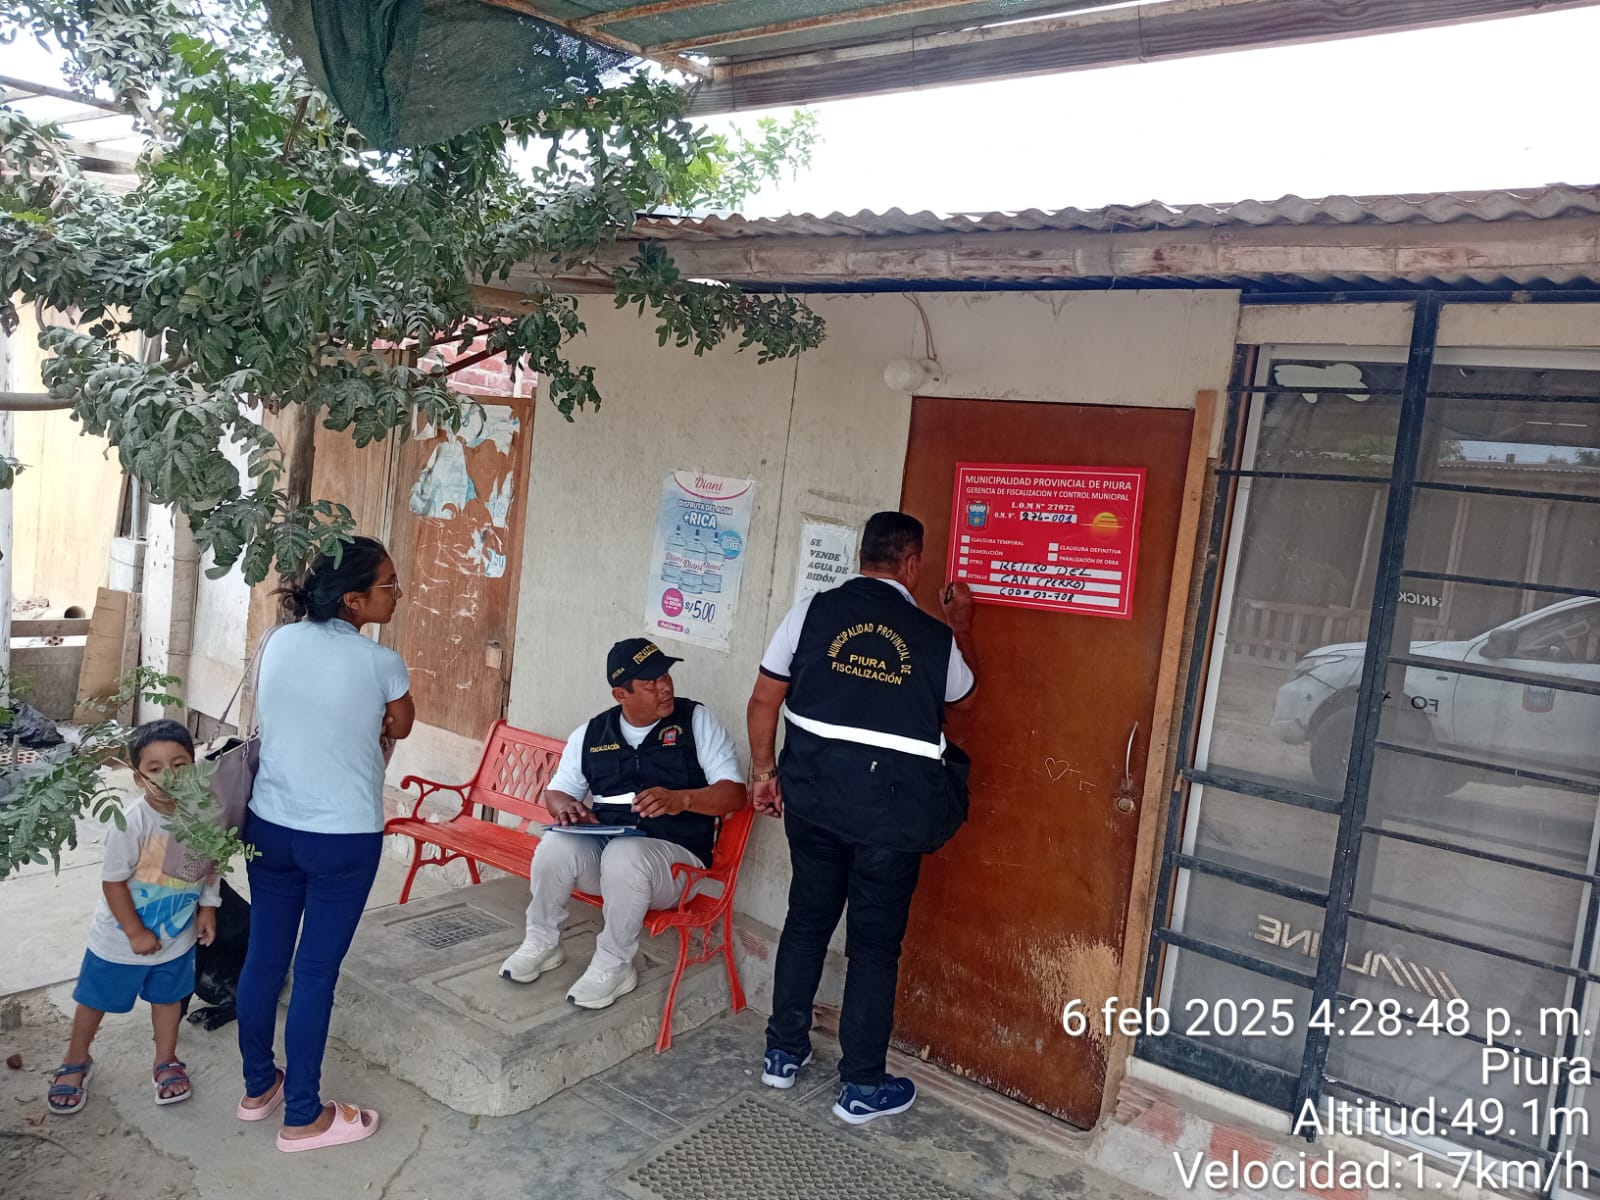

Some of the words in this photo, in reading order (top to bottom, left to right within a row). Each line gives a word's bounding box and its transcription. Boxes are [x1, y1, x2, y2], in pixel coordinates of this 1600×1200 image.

[694, 476, 723, 492] Diani
[965, 475, 1032, 486] MUNICIPALIDAD
[1033, 478, 1086, 488] PROVINCIAL
[1088, 480, 1101, 489] DE
[1103, 480, 1132, 490] PIURA
[966, 486, 996, 495] GERENCIA
[1059, 490, 1091, 499] CONTROL
[1091, 493, 1129, 501] MUNICIPAL
[683, 512, 718, 529] +RICA
[810, 538, 822, 547] SE
[810, 549, 841, 562] VENDE
[807, 560, 833, 573] AGUA
[834, 565, 849, 575] DE
[1000, 561, 1048, 572] RETIRO
[1055, 565, 1093, 577] DEL
[806, 571, 837, 584] BIDÓN
[1000, 574, 1031, 585] CAN
[1036, 576, 1086, 591] (PERRO)
[827, 622, 875, 658] MUNICIPALIDAD
[876, 624, 911, 662] PROVINCIAL
[900, 664, 912, 675] DE
[849, 654, 887, 670] PIURA
[831, 661, 903, 685] FISCALIZACIÓN
